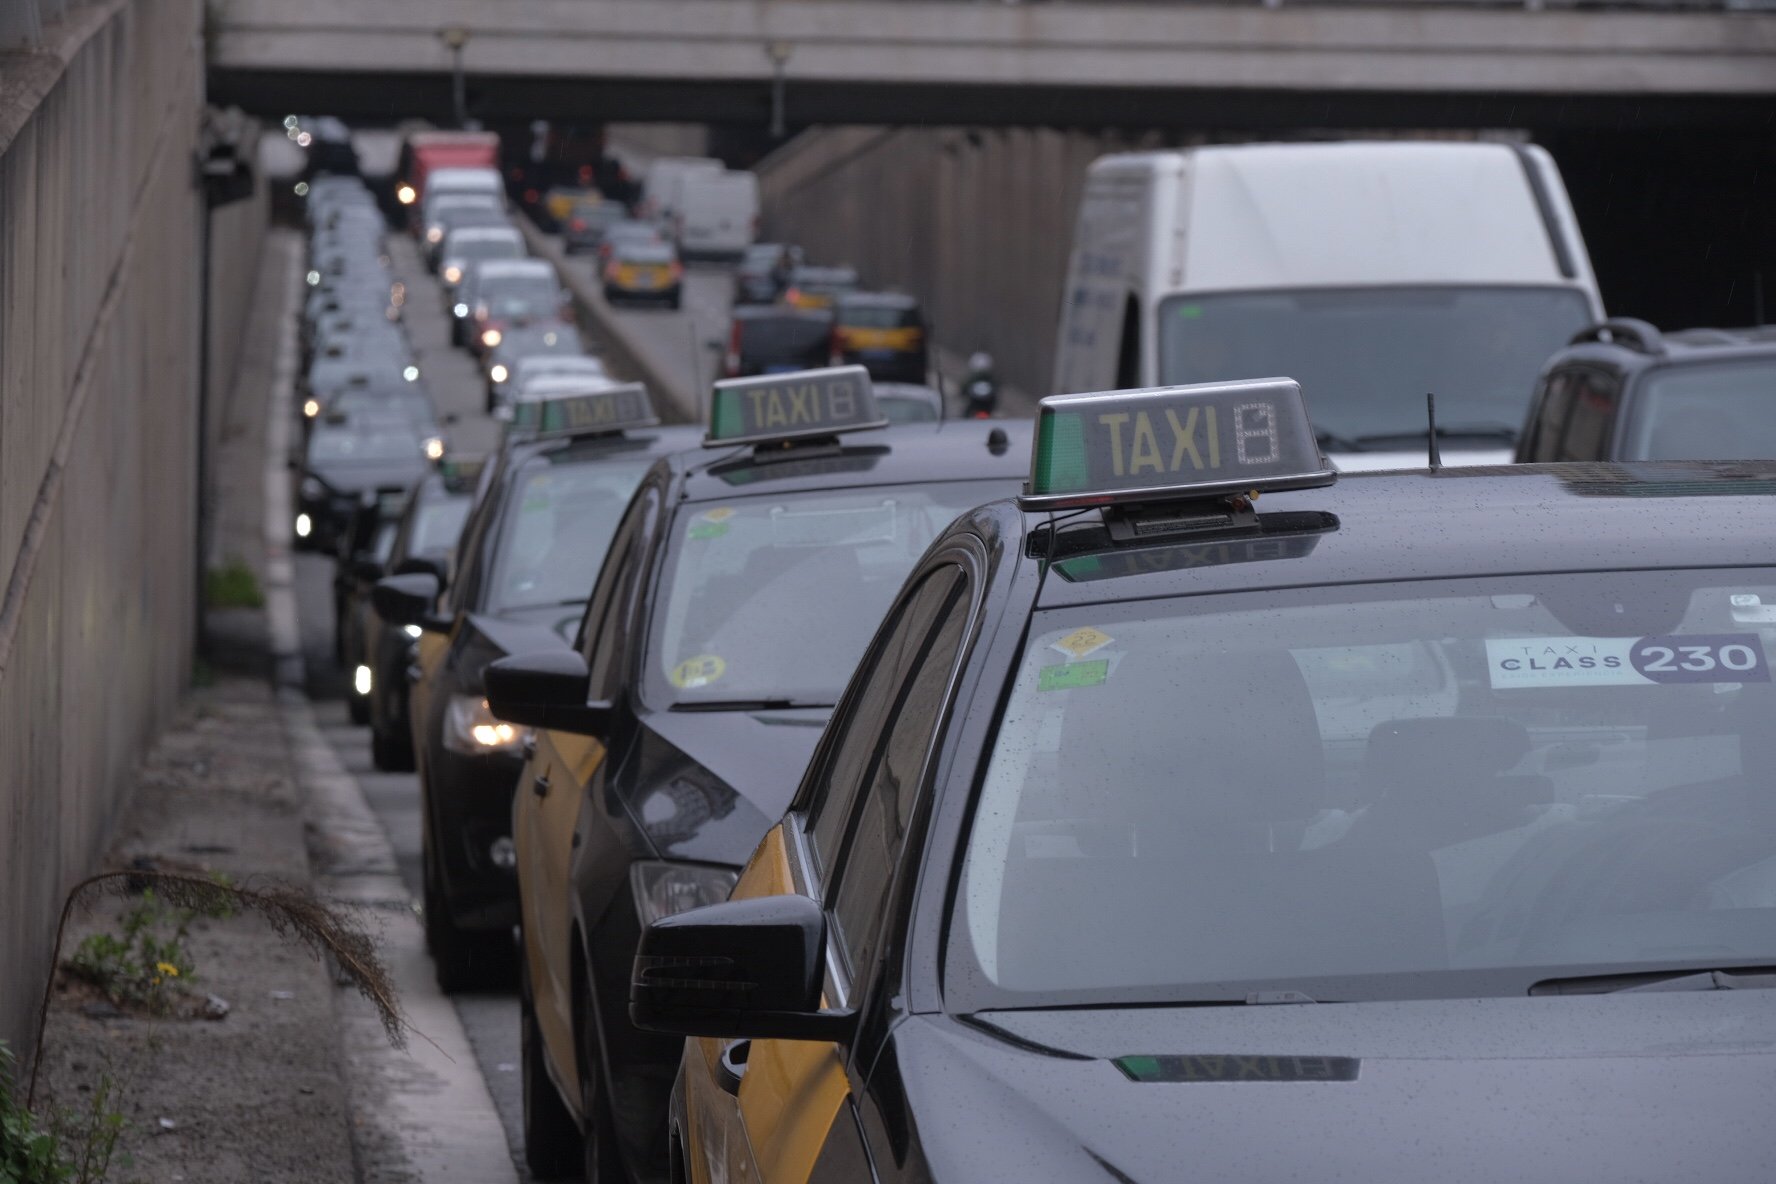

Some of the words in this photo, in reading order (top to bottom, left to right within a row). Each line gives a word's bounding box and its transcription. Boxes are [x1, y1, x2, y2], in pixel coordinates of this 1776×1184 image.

[747, 384, 821, 429] TAXI
[1099, 405, 1221, 477] TAXI
[1500, 656, 1622, 671] CLASS
[1640, 644, 1757, 672] 230
[1520, 645, 1598, 656] TAXI
